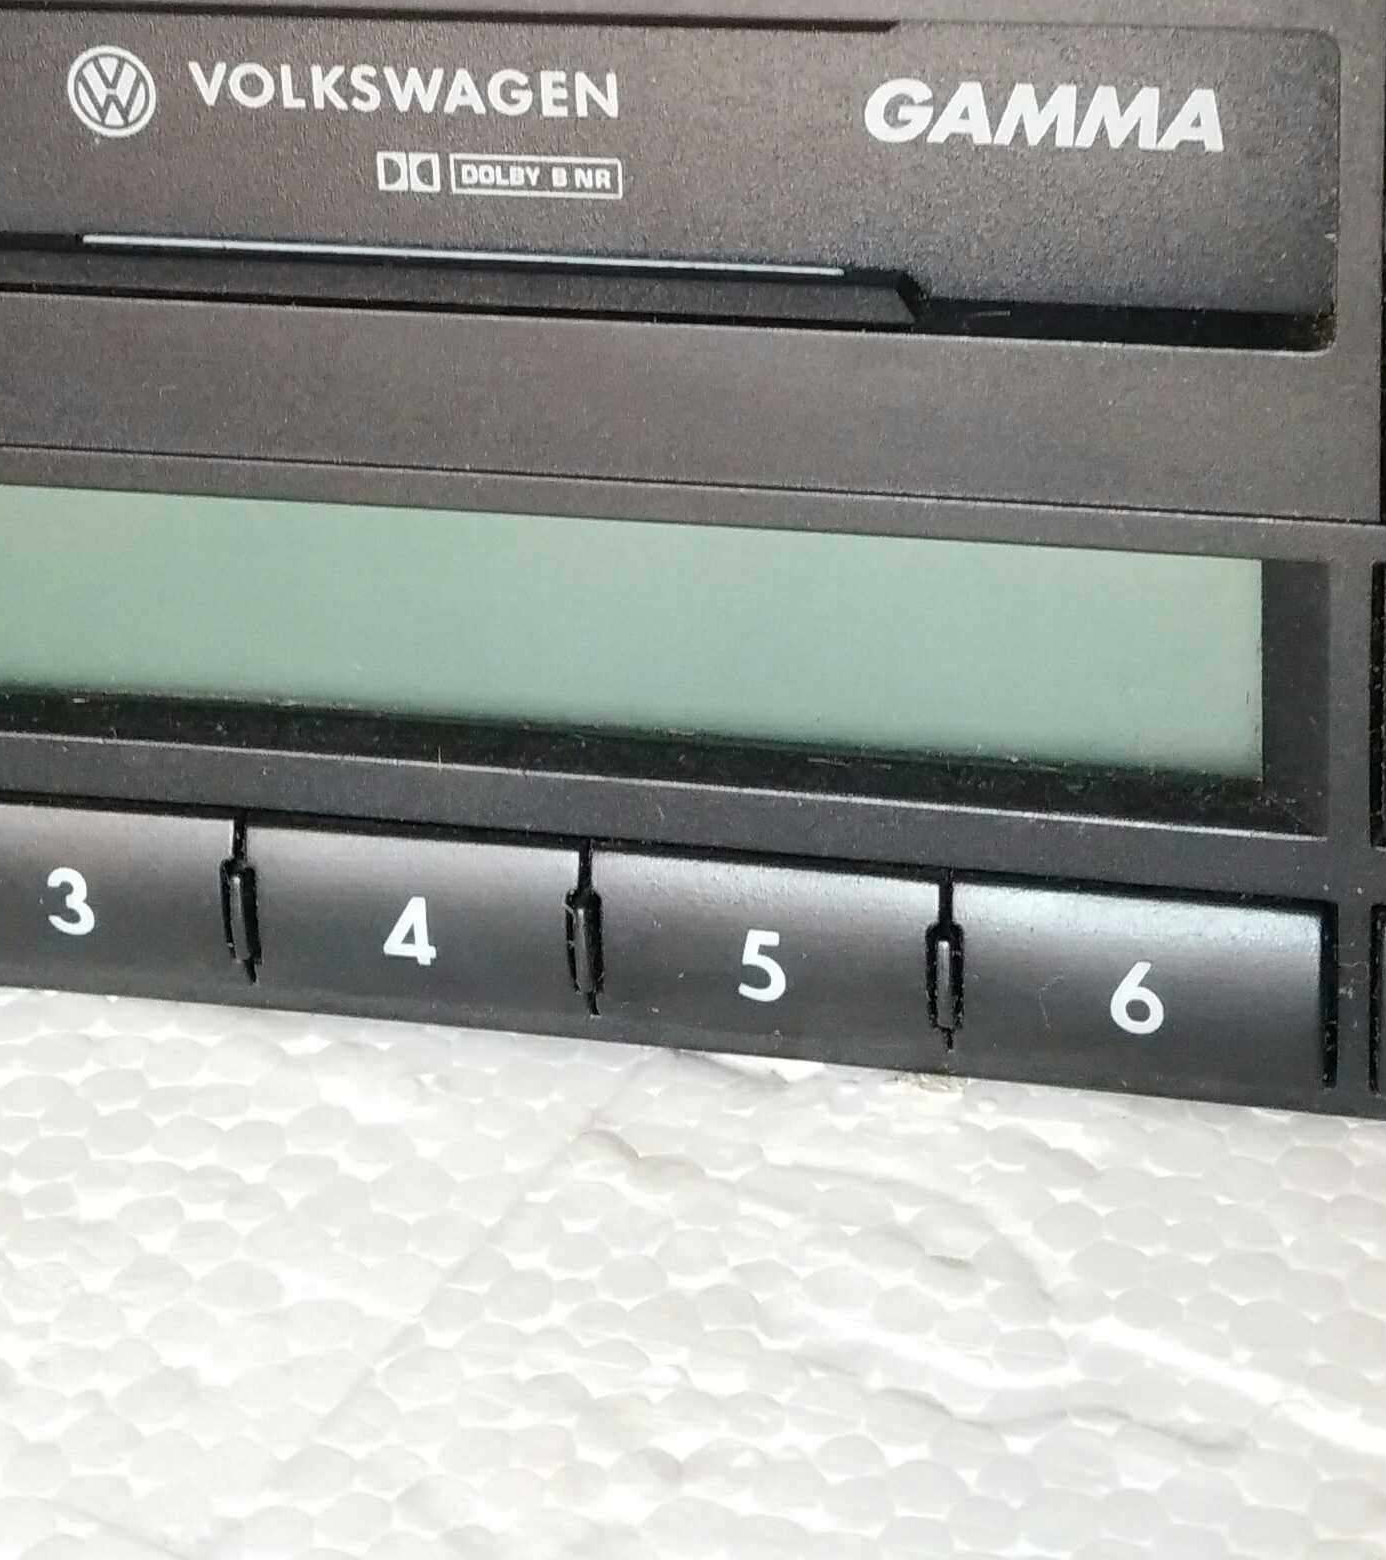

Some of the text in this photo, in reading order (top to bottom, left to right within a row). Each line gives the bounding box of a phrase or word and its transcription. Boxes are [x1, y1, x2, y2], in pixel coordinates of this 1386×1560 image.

[187, 60, 620, 119] VOLKSWAGEN
[863, 77, 1224, 153] GAMMA
[461, 163, 611, 189] DOLBY B NR
[47, 866, 96, 936] 3
[383, 895, 437, 966] 4
[738, 928, 787, 1002] 5
[1109, 960, 1165, 1034] 6
